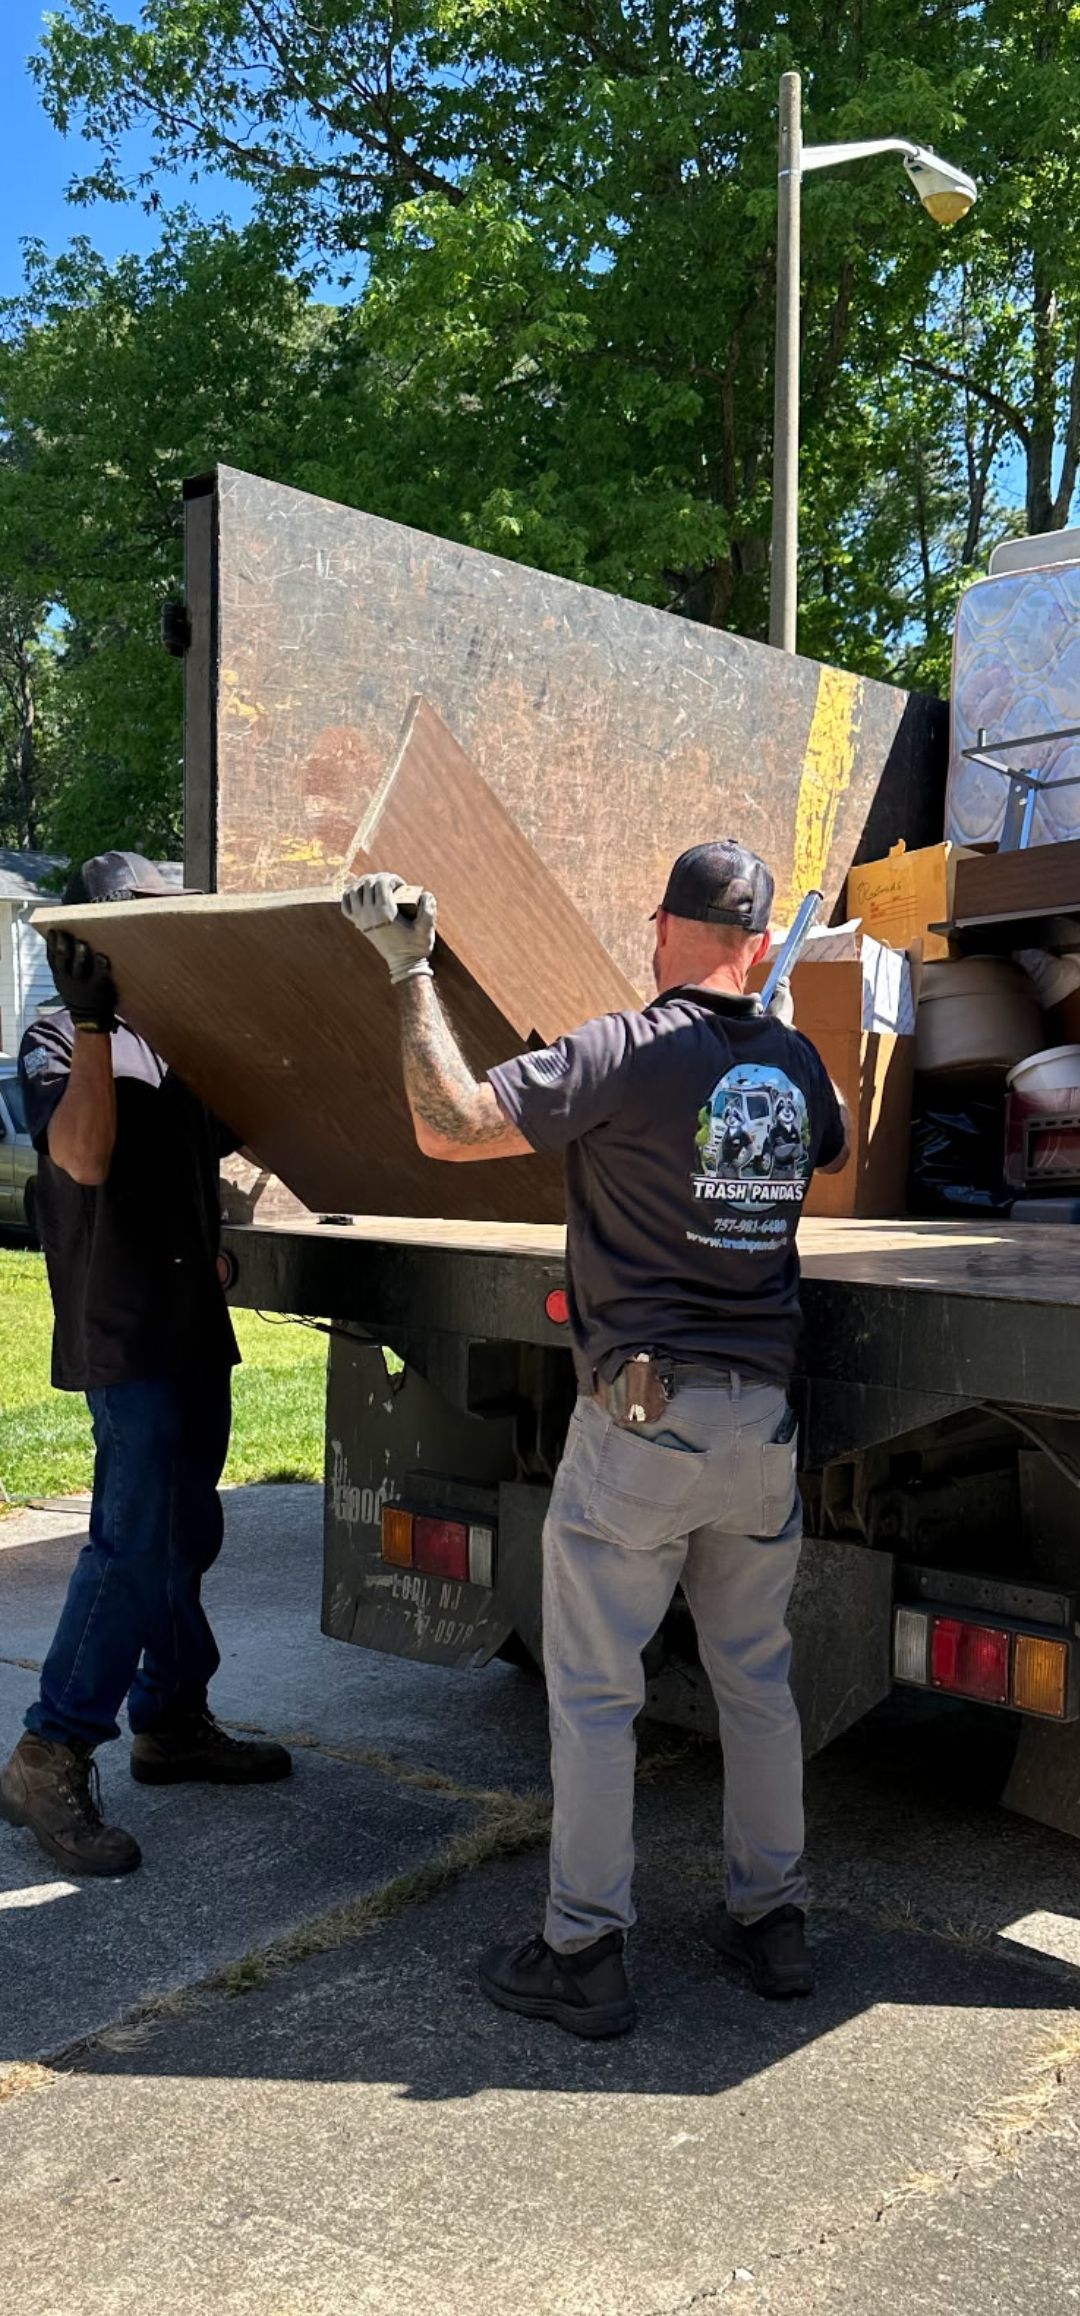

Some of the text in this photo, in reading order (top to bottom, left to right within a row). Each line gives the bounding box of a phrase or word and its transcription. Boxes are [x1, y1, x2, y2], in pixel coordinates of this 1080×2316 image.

[693, 1181, 804, 1201] TRASH PANDAS
[439, 1582, 462, 1611] NJ
